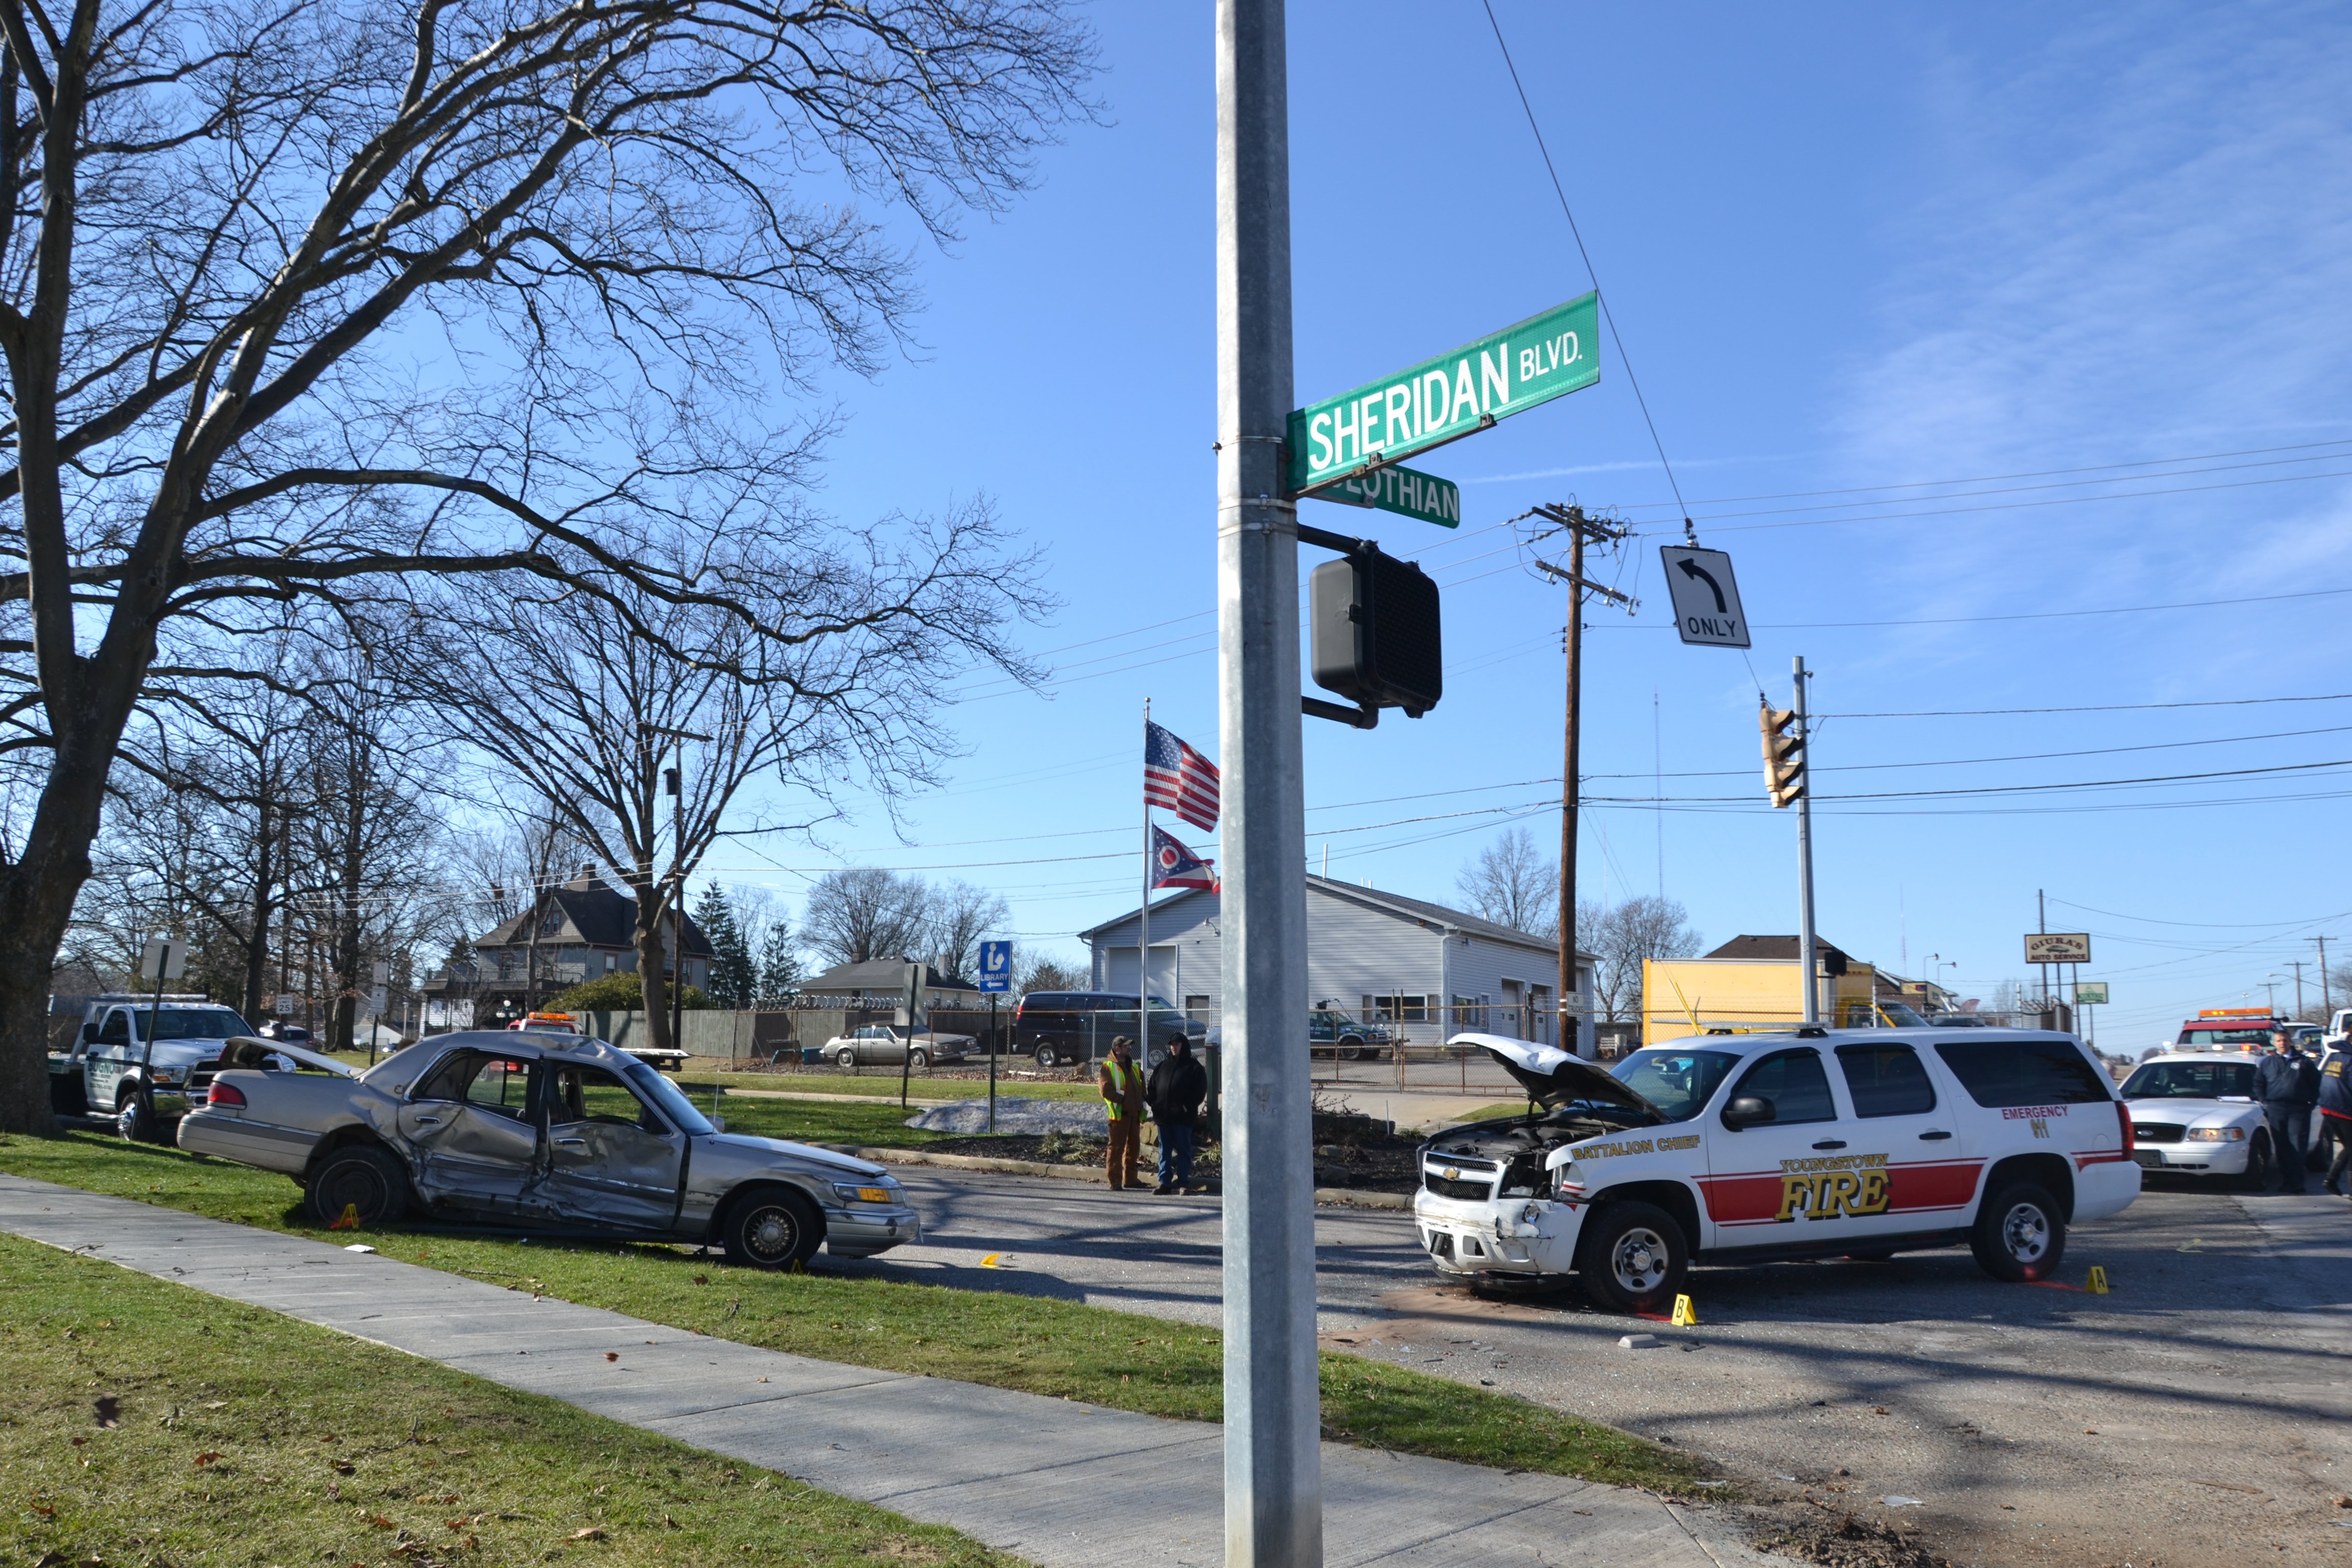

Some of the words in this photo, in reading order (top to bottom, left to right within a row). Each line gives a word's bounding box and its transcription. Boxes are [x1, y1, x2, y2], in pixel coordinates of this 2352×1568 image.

[1309, 342, 1509, 470] SHERIDAN
[1520, 331, 1583, 382] BLVD.
[1687, 617, 1736, 638] ONLY
[2031, 937, 2084, 950] GIURA'S
[981, 973, 1009, 982] LIBRARY
[1568, 1004, 1583, 1013] TRUCKS
[1573, 995, 1579, 1003] NO
[88, 1060, 115, 1074] BUGNO
[2001, 1105, 2069, 1120] EMERGENCY
[2030, 1118, 2050, 1139] 911
[1571, 1139, 1654, 1161] BATTALION
[1657, 1135, 1701, 1152] CHIEF
[1780, 1154, 1889, 1173] YOUNGSTOWN
[1774, 1168, 1891, 1221] FIRE
[2096, 1268, 2105, 1288] A
[1676, 1298, 1684, 1318] B
